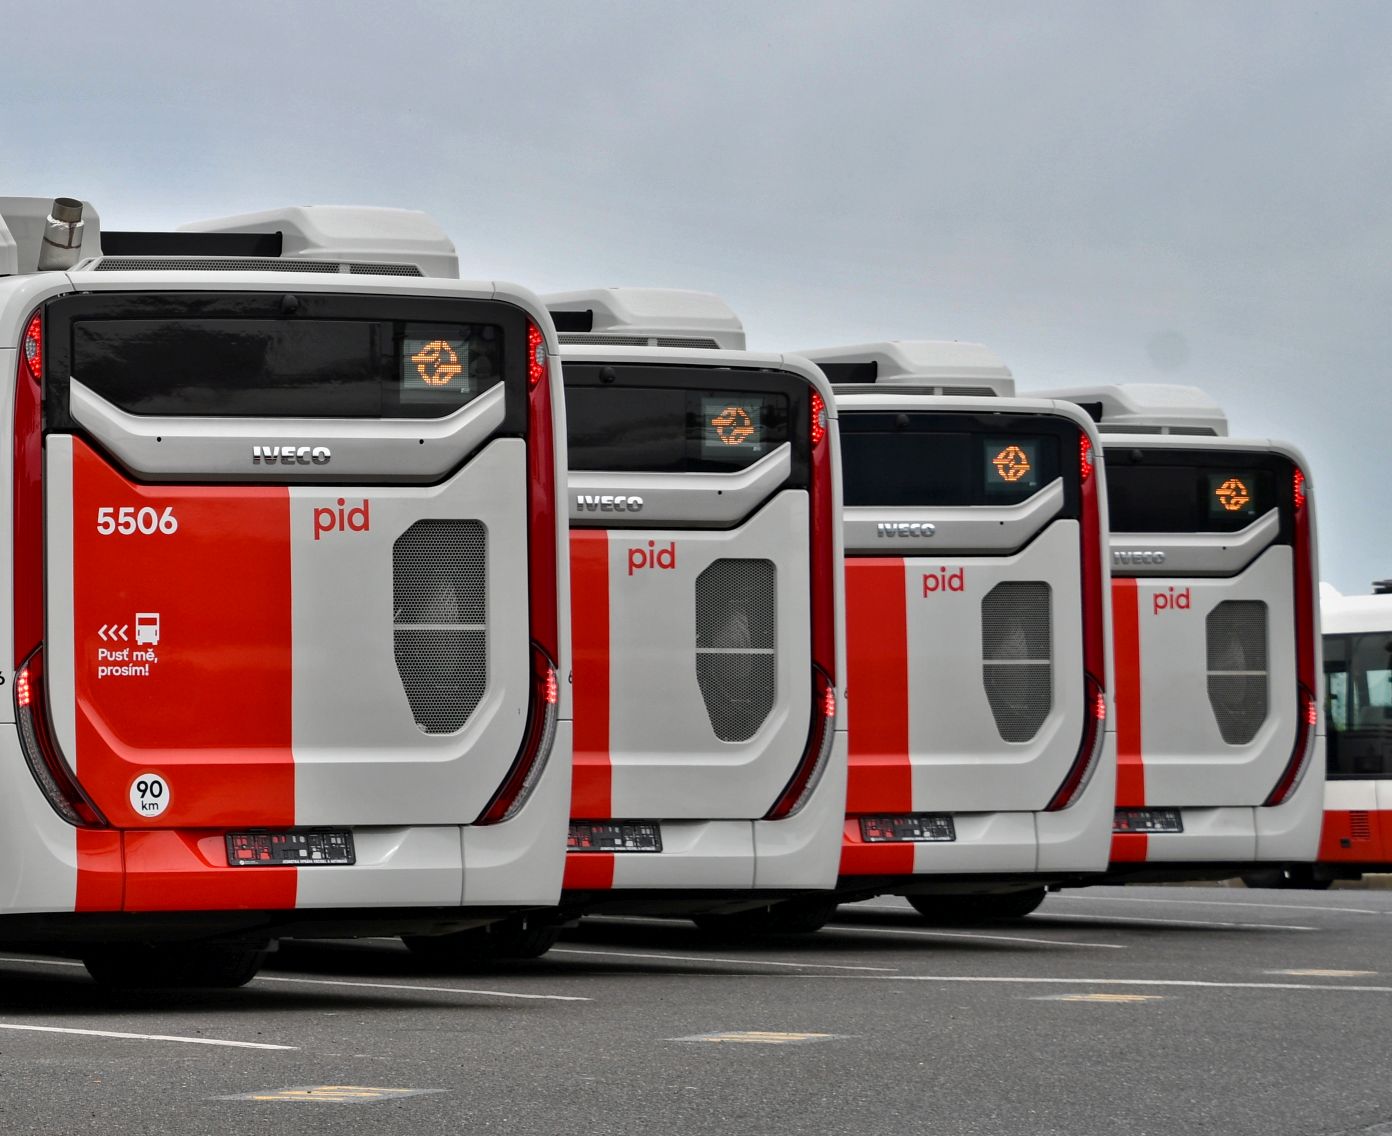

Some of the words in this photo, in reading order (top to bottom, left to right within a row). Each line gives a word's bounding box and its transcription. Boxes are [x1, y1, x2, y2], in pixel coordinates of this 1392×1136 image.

[253, 446, 331, 465] IVECO
[577, 496, 644, 512] IVECO
[96, 506, 179, 536] 5506
[313, 498, 370, 540] pid
[877, 523, 936, 538] IVECO
[627, 541, 677, 577] pid
[1114, 551, 1165, 566] IVECO
[922, 566, 966, 598] pid
[1152, 587, 1192, 615] pid
[98, 648, 129, 661] Pusť
[132, 648, 158, 664] mě,
[98, 663, 150, 679] prosím!
[136, 778, 163, 799] 90
[141, 800, 159, 811] km
